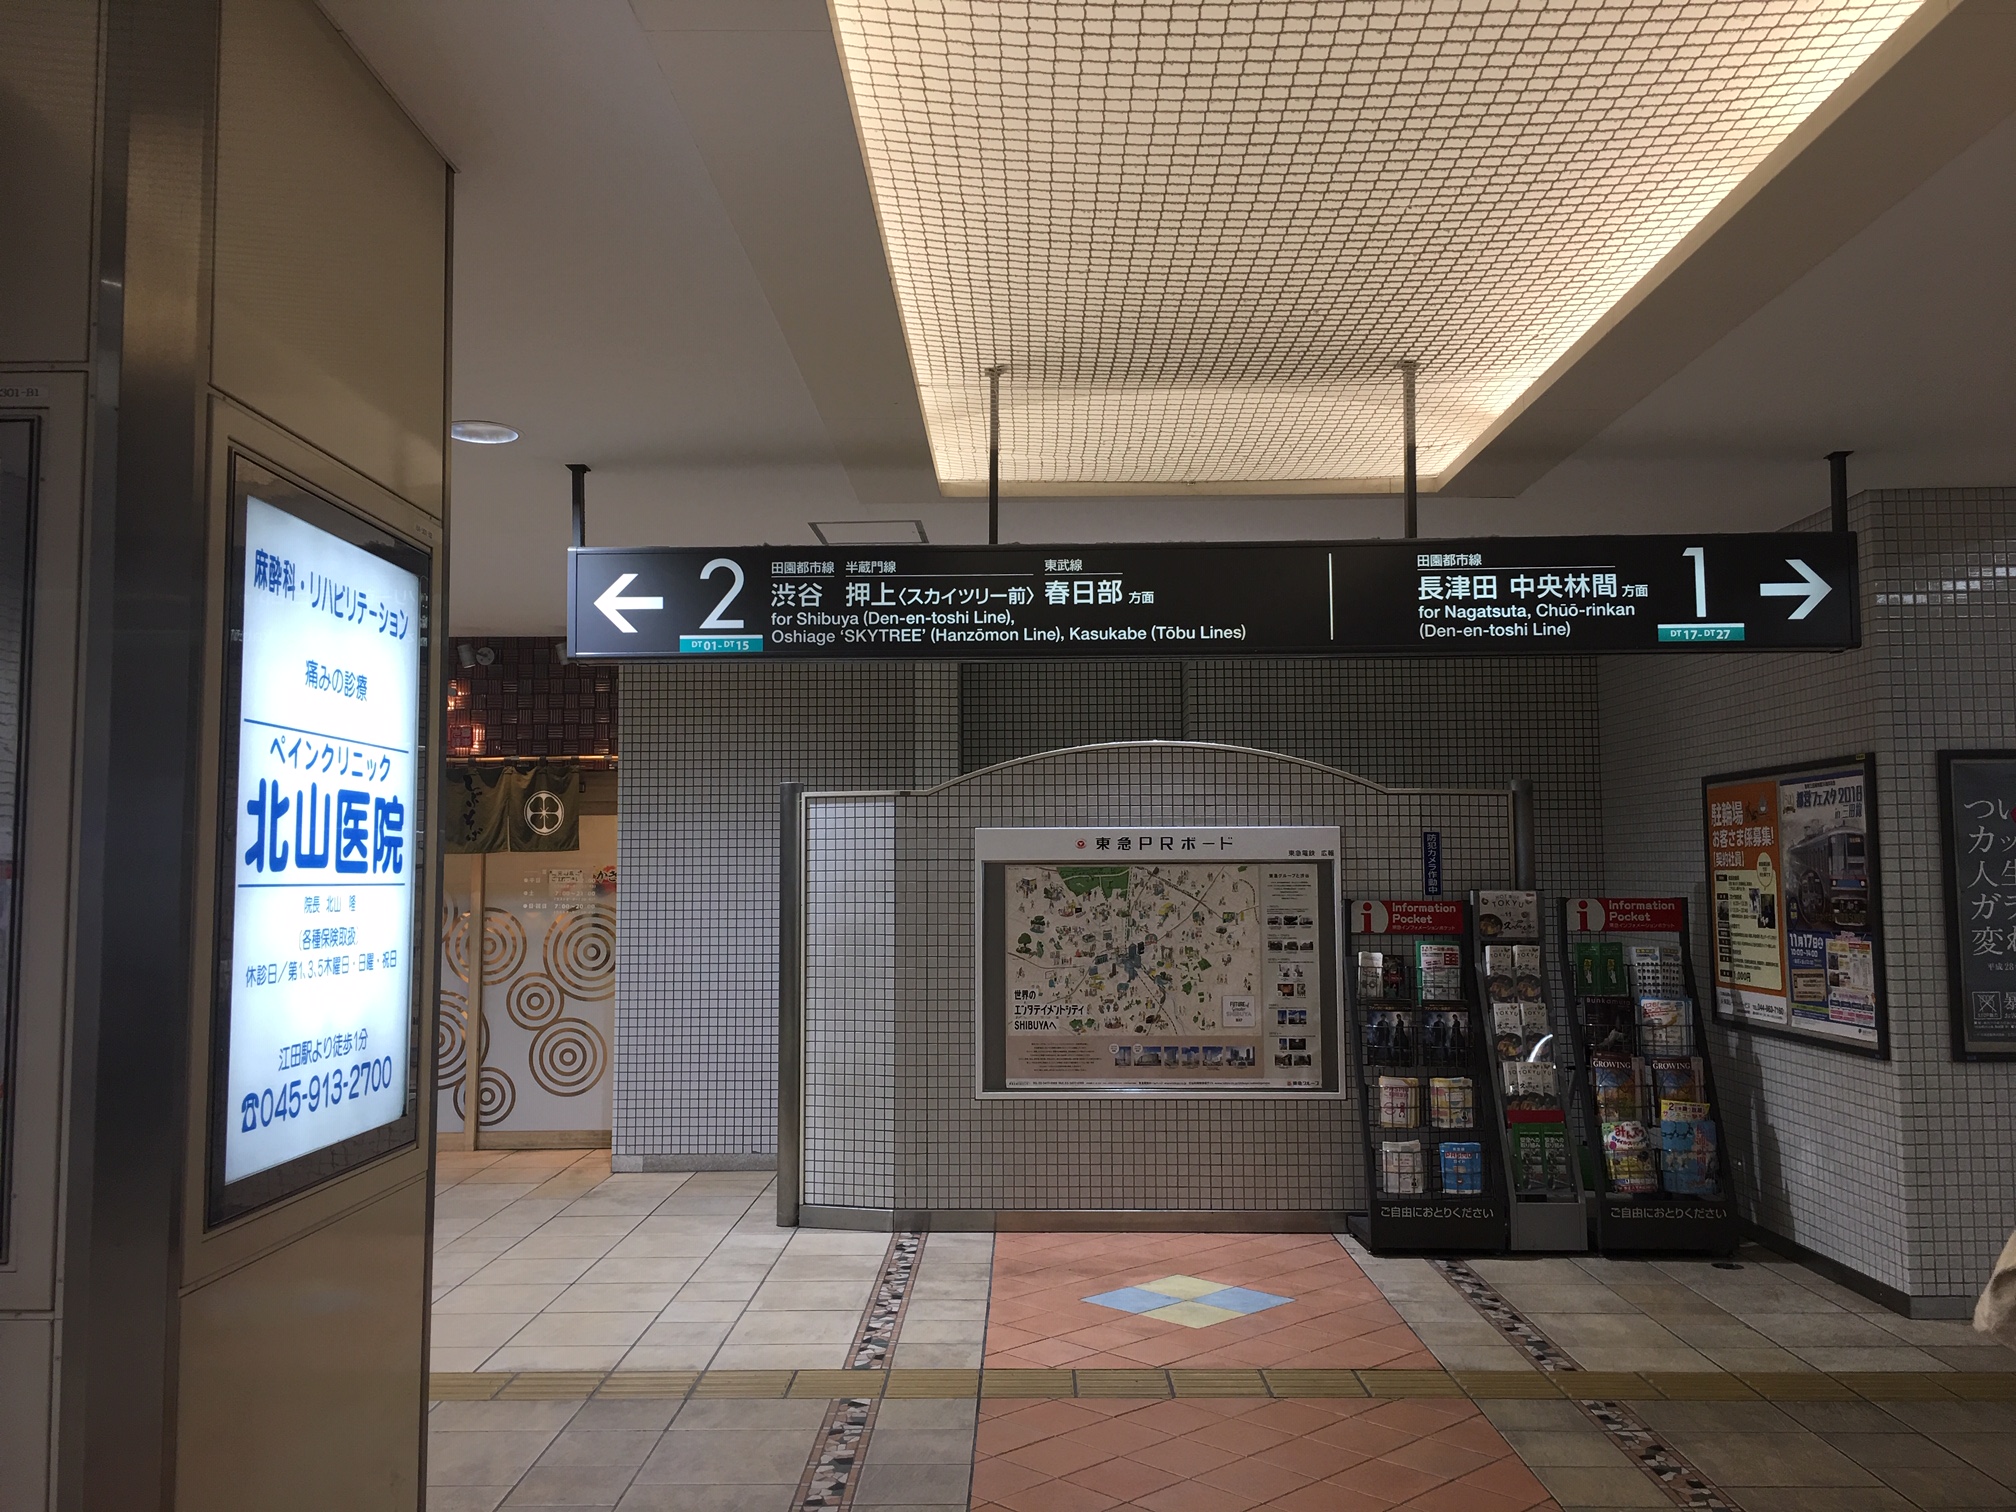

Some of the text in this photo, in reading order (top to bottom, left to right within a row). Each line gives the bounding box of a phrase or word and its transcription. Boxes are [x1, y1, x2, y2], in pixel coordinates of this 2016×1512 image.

[771, 559, 1083, 574] 田園都市線 半蔵門線 東武線
[1417, 554, 1483, 568] 田園都市線
[1418, 573, 1649, 601] 長津田 中央林間 方面
[1682, 547, 1707, 618] 1
[254, 548, 409, 641] 麻酔科・リハビリテーション
[699, 557, 745, 629] 2
[771, 582, 823, 608] 渋谷
[1044, 579, 1123, 605] 春日部
[1128, 591, 1154, 605] 方面
[771, 610, 1015, 629] for Shibuya (Den-en-toshi Line),
[1418, 602, 1636, 623] for Nagatsuta, Chūō-rinkan
[771, 629, 836, 648] Oshiage
[930, 627, 1019, 644] (Hanzōmon
[1023, 627, 1065, 643] Line),
[1069, 626, 1147, 641] Kasukabe
[1151, 625, 1196, 642] (Tōbu
[1200, 624, 1246, 641] Lines)
[1419, 621, 1571, 639] (Den-en-toshi Line)
[305, 659, 368, 702] 痛みの診療
[270, 735, 391, 782] ペインクリニック
[1711, 801, 1744, 827] 駐輪場
[245, 777, 405, 874] 北山医院
[1095, 836, 1233, 851] 東急PRボード
[1426, 833, 1438, 894] 防犯カメラ作動中
[304, 895, 320, 914] 院長
[1392, 902, 1457, 913] Information
[1492, 900, 1524, 908] TOKYU
[1608, 900, 1675, 910] Information
[1392, 914, 1433, 924] Pocket
[1609, 911, 1651, 922] Pocket
[1014, 990, 1037, 1000] 世界の
[1014, 1004, 1085, 1016] エンタテイメントシティ
[1014, 1020, 1057, 1030] SHIBUYAへ
[278, 1027, 369, 1071] 江田駅より徒歩1分
[1592, 1061, 1631, 1069] GROWING
[1652, 1062, 1691, 1070] GROWING
[260, 1055, 393, 1127] 045-913-2700
[1380, 1206, 1494, 1219] ご自由におとりください
[1610, 1207, 1727, 1220] ご自由におとりください
